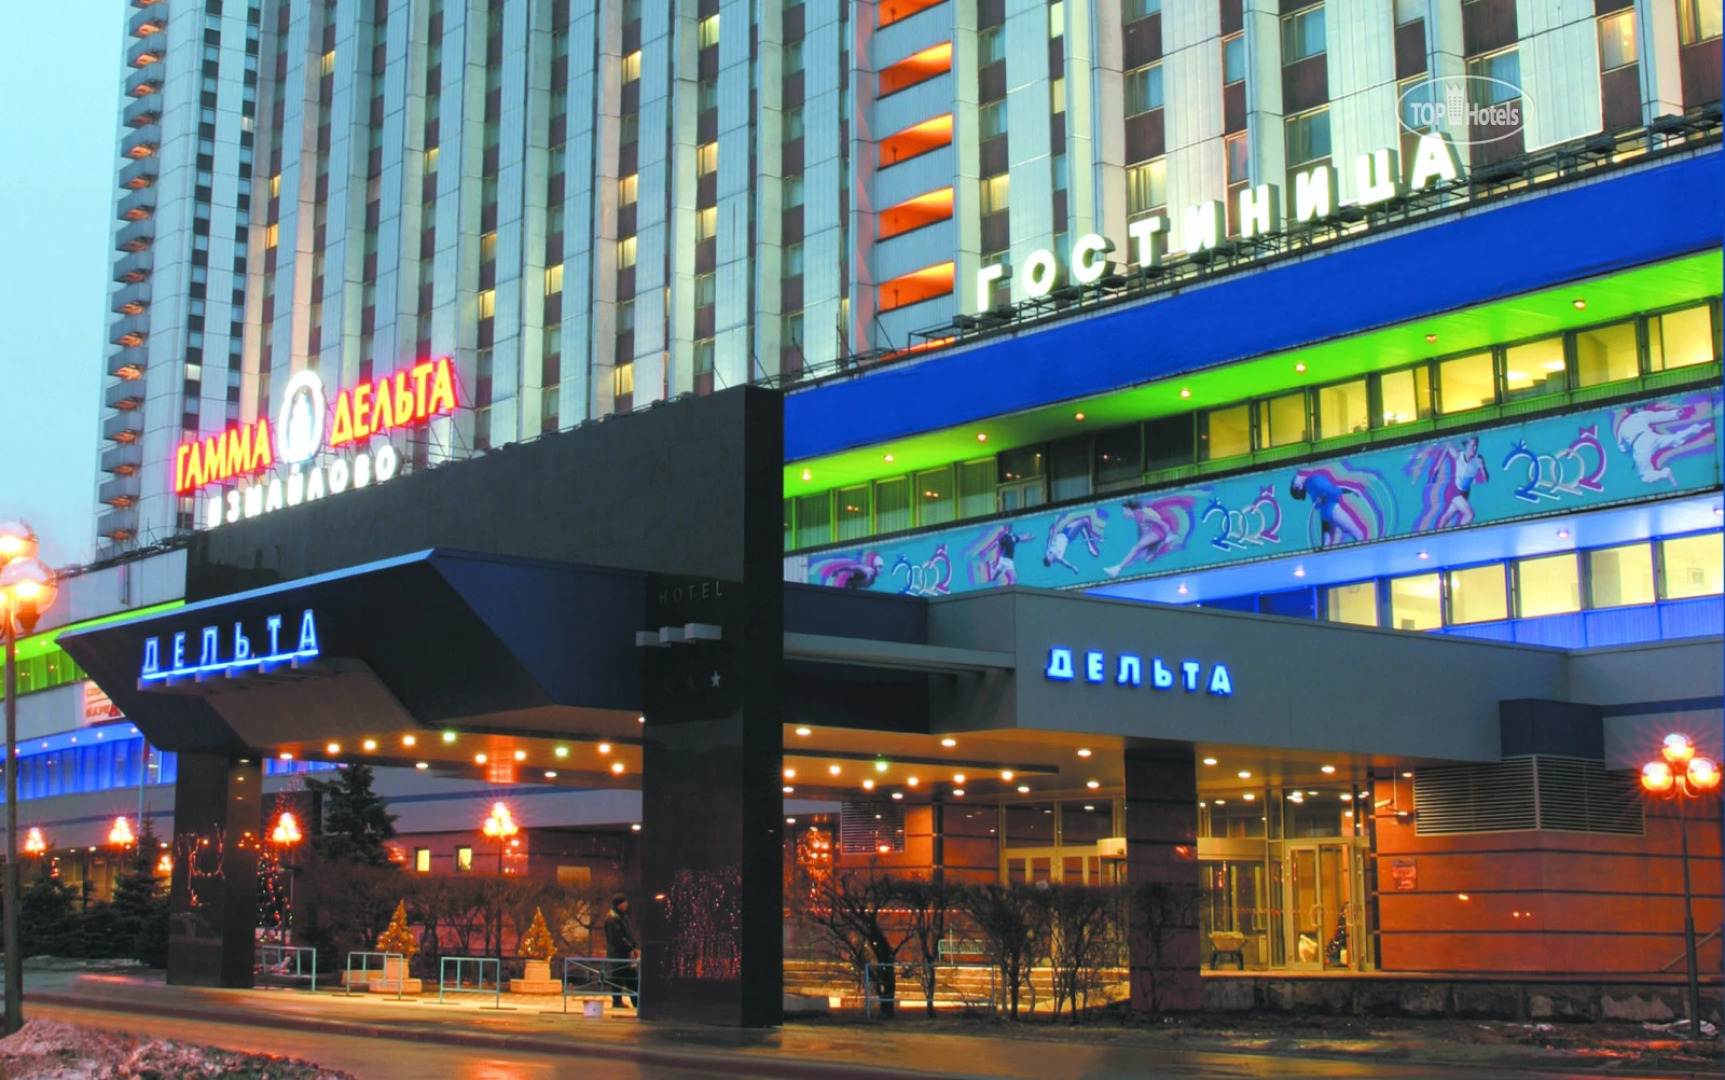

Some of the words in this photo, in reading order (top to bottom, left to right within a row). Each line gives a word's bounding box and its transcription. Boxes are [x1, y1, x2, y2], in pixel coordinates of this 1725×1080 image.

[977, 131, 1463, 313] ГОСТИНИЦА
[175, 417, 272, 491] ГАММА
[329, 357, 456, 446] ДЕЛЬТА
[207, 444, 397, 528] ИЗМАЙЛОВО
[659, 580, 723, 605] HOTEL
[142, 609, 318, 674] ДЕЛЬТА
[1046, 646, 1233, 696] ДЕЛЬТА
